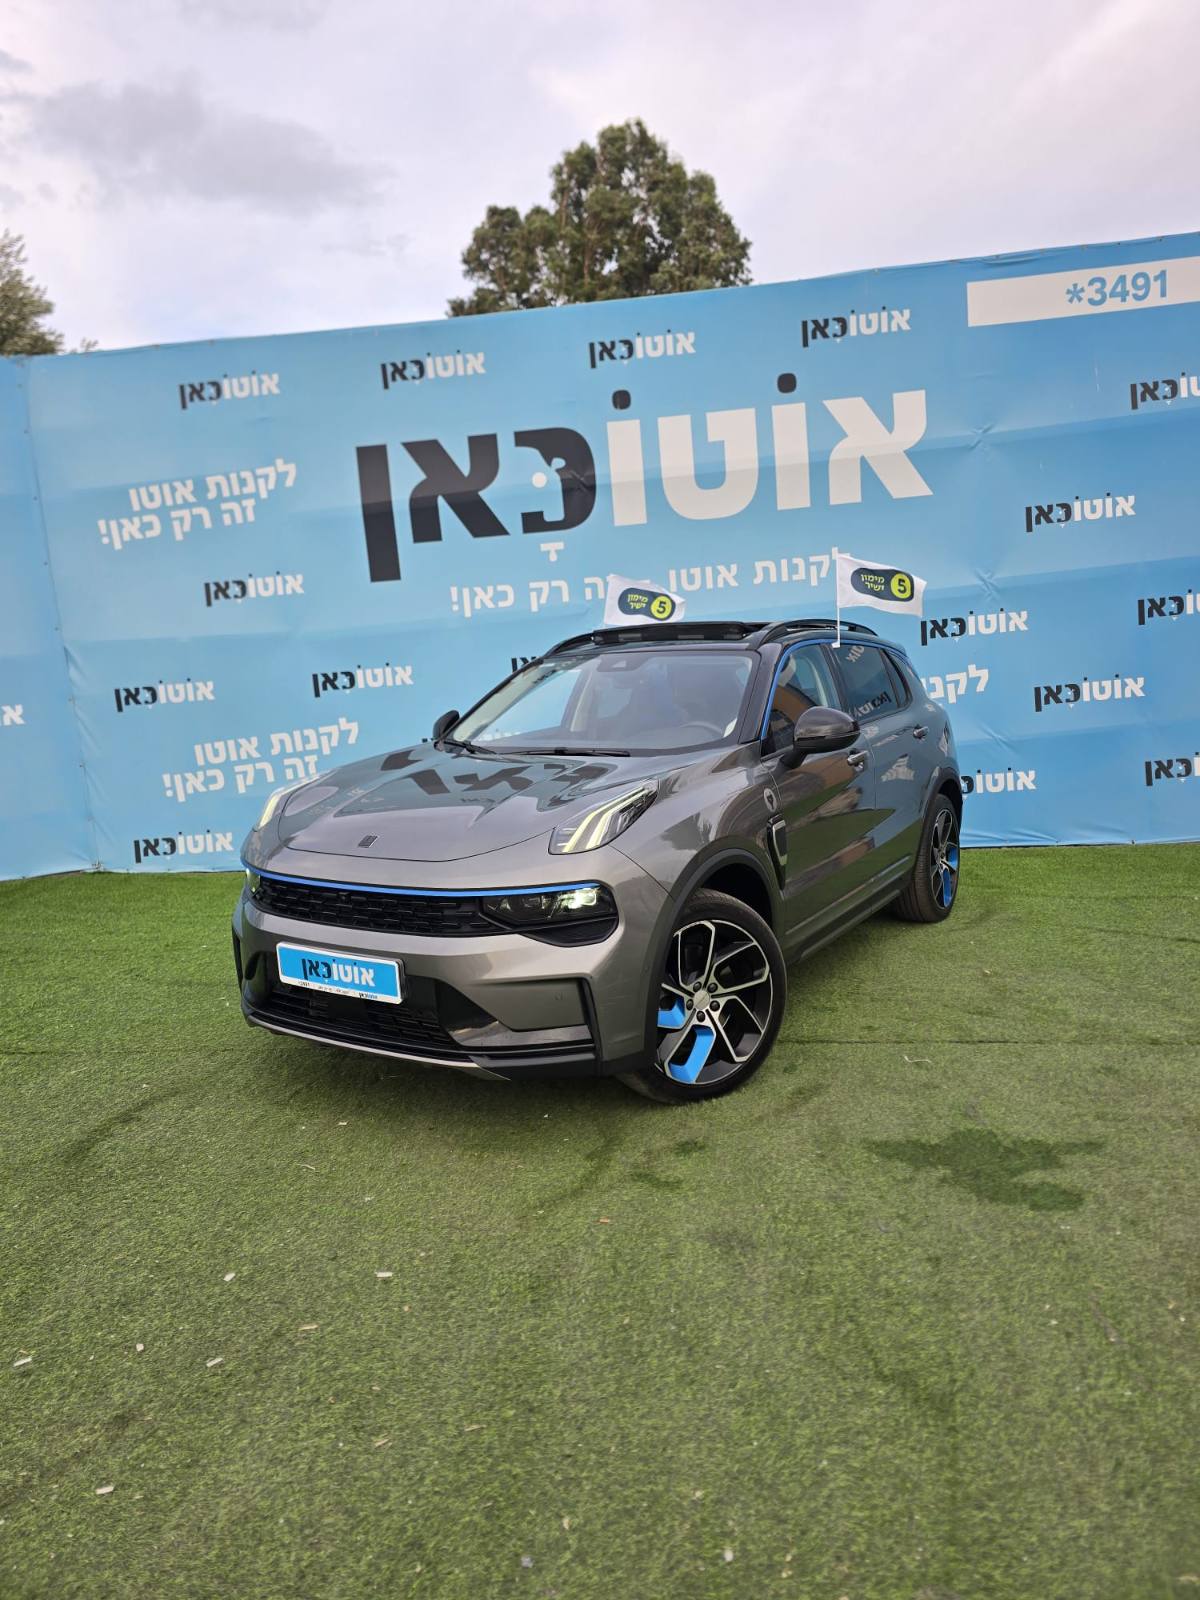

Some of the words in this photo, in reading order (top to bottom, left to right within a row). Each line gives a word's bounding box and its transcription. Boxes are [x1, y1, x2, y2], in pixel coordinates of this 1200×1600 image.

[128, 479, 197, 512] אוטו
[205, 458, 297, 500] לקנות
[170, 506, 213, 541] רק
[220, 498, 257, 526] זה
[97, 513, 162, 551] כאן!
[669, 563, 740, 593] אוטו
[897, 577, 908, 594] 5
[449, 584, 516, 618] כאן!
[529, 579, 570, 613] רק
[656, 600, 666, 615] 5
[920, 665, 989, 704] לקנ
[194, 736, 261, 766] אוטו
[270, 716, 359, 755] לקנות
[233, 761, 275, 794] רק
[284, 754, 319, 782] זה
[162, 768, 226, 803] כאן!
